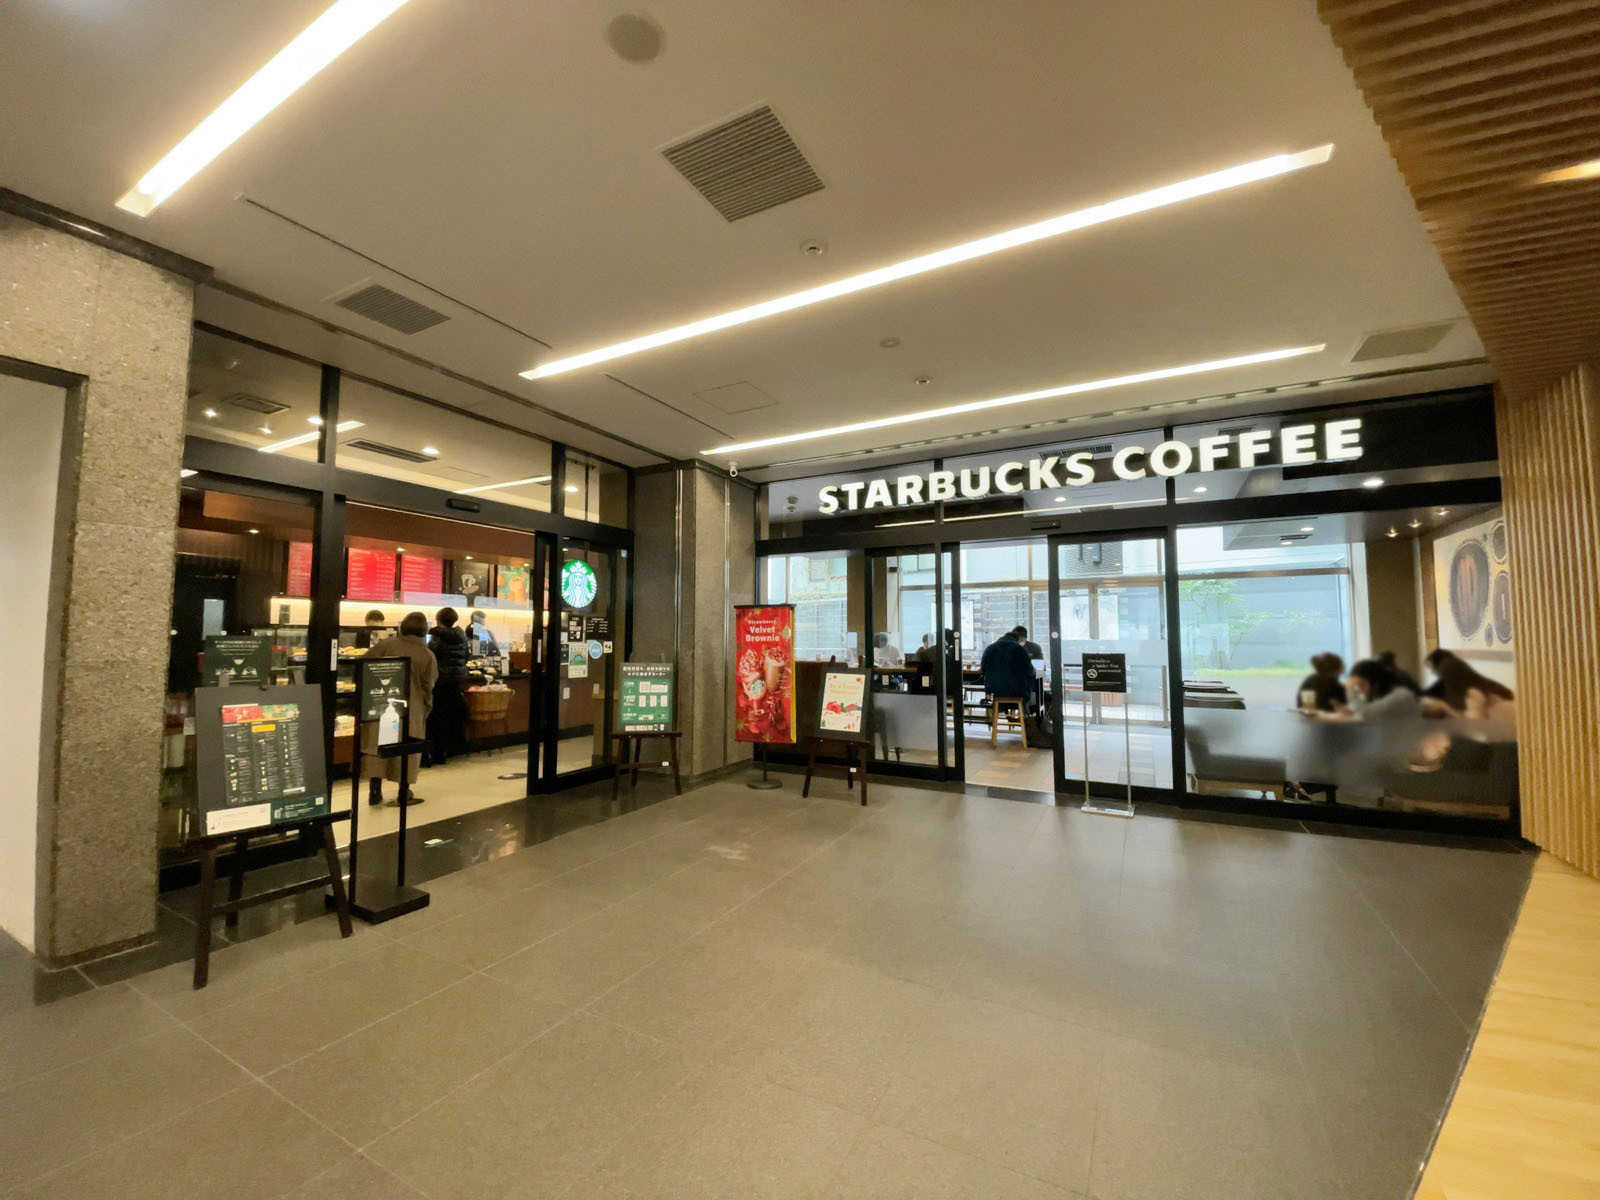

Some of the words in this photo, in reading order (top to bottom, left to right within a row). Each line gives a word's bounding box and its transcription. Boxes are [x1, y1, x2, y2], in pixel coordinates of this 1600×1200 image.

[818, 452, 1096, 516] STARBUCKS
[1112, 418, 1363, 481] COFFEE
[750, 626, 776, 634] Velvet
[746, 634, 780, 642] Brownie
